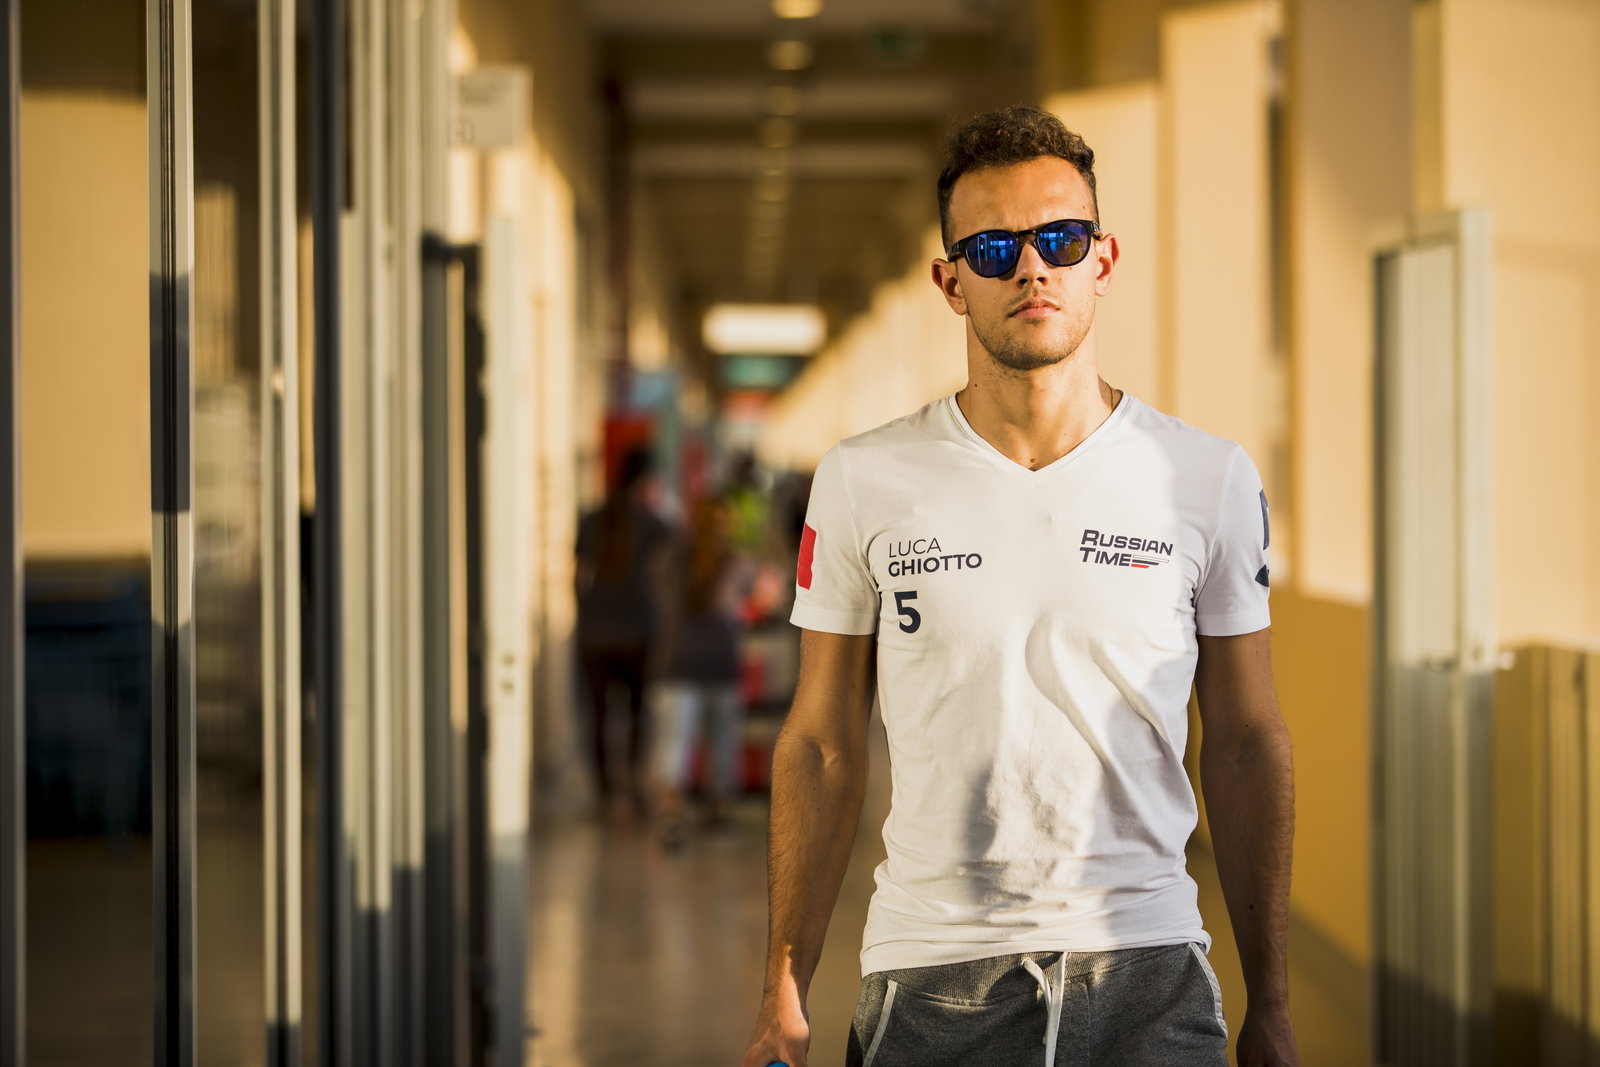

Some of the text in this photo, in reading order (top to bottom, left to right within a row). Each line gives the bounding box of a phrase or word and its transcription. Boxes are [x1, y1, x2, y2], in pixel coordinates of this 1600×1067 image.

[888, 537, 942, 558] LUCA
[1080, 529, 1174, 556] RUSSIAN
[888, 553, 983, 577] GHIOTTO
[1079, 546, 1132, 567] TIME
[893, 590, 922, 634] 5
